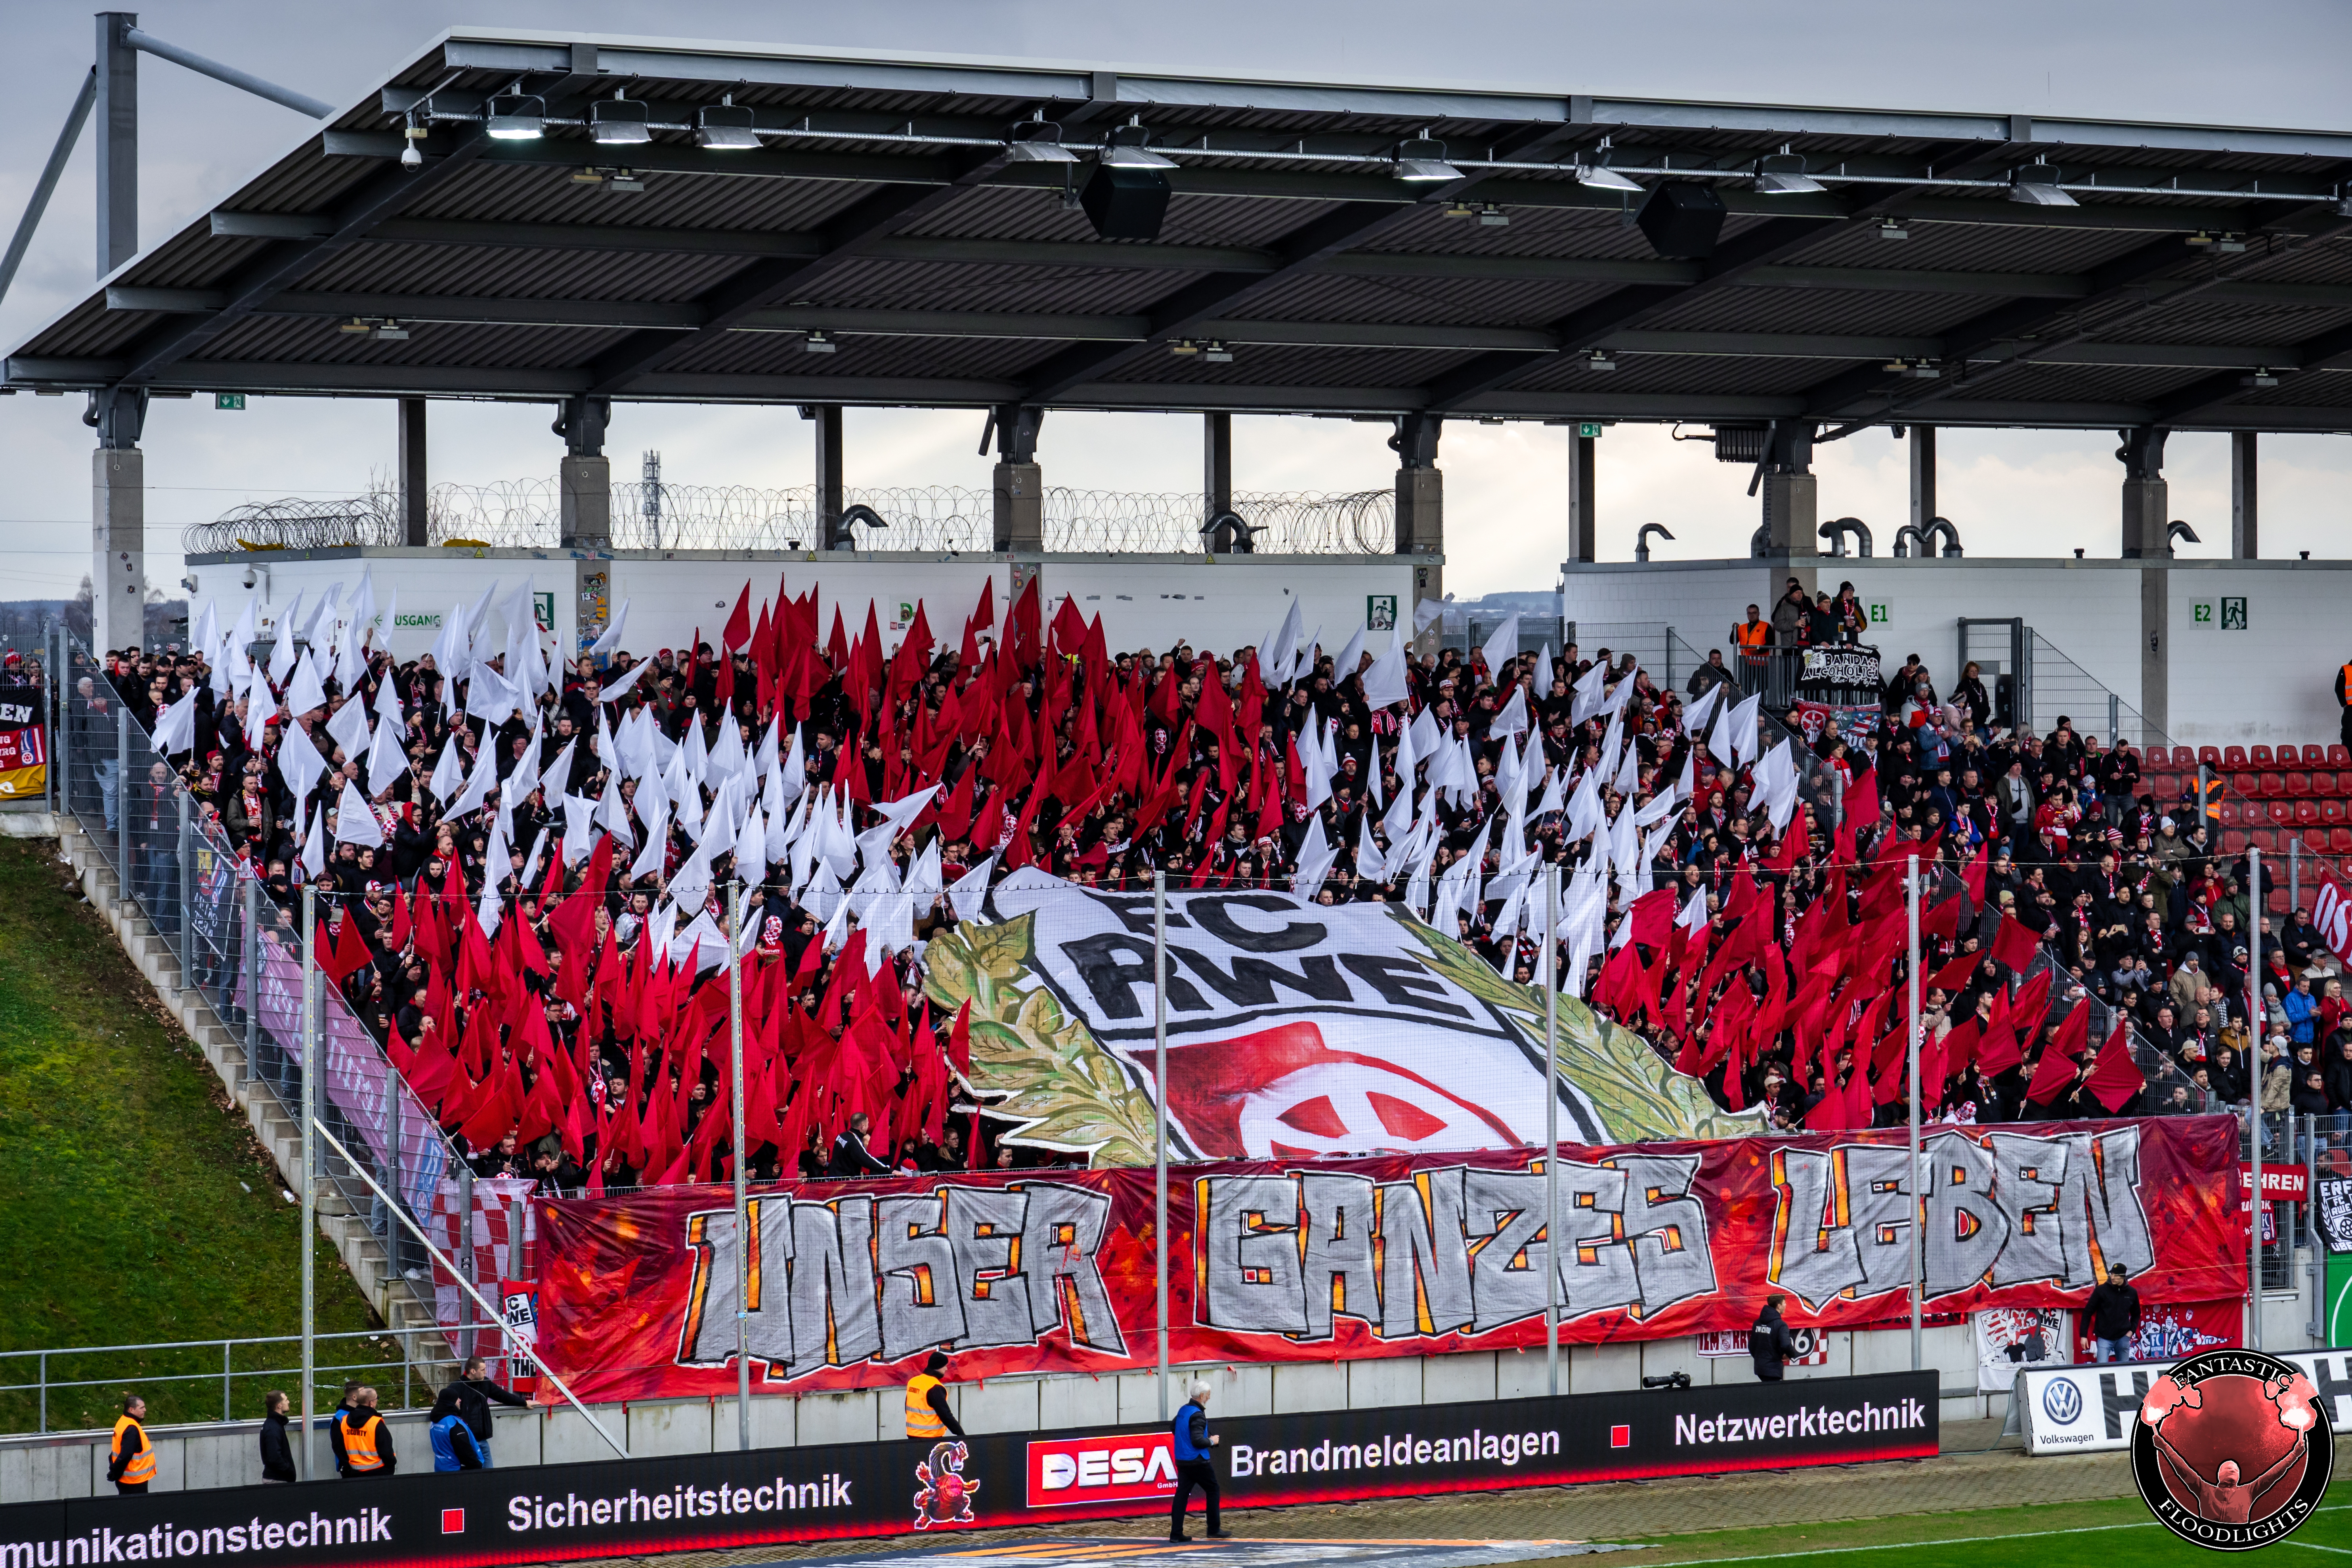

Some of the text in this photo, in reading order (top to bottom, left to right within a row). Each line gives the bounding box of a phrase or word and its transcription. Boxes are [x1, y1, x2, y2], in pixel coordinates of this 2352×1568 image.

[395, 615, 441, 626] USGANG
[1871, 604, 1888, 622] E1
[2195, 604, 2211, 622] E2
[1801, 665, 1879, 681] ALCOHOLICA
[1825, 653, 1868, 667] BANDA
[1080, 888, 1328, 952] FC
[1058, 932, 1475, 1020] RWE
[2331, 1203, 2352, 1216] RWE
[2333, 1197, 2345, 1207] FC
[674, 1125, 2155, 1383] UNSER GANZES LEBEN
[1675, 1398, 1926, 1446] Netzwerktechnik
[1231, 1429, 1560, 1478] Brandmeldeanlagen
[2040, 1432, 2094, 1445] Volkswagen
[1042, 1446, 1178, 1490] DESA
[508, 1473, 852, 1532] Sicherheitstechnik
[0, 1507, 393, 1568] munikationstechnik
